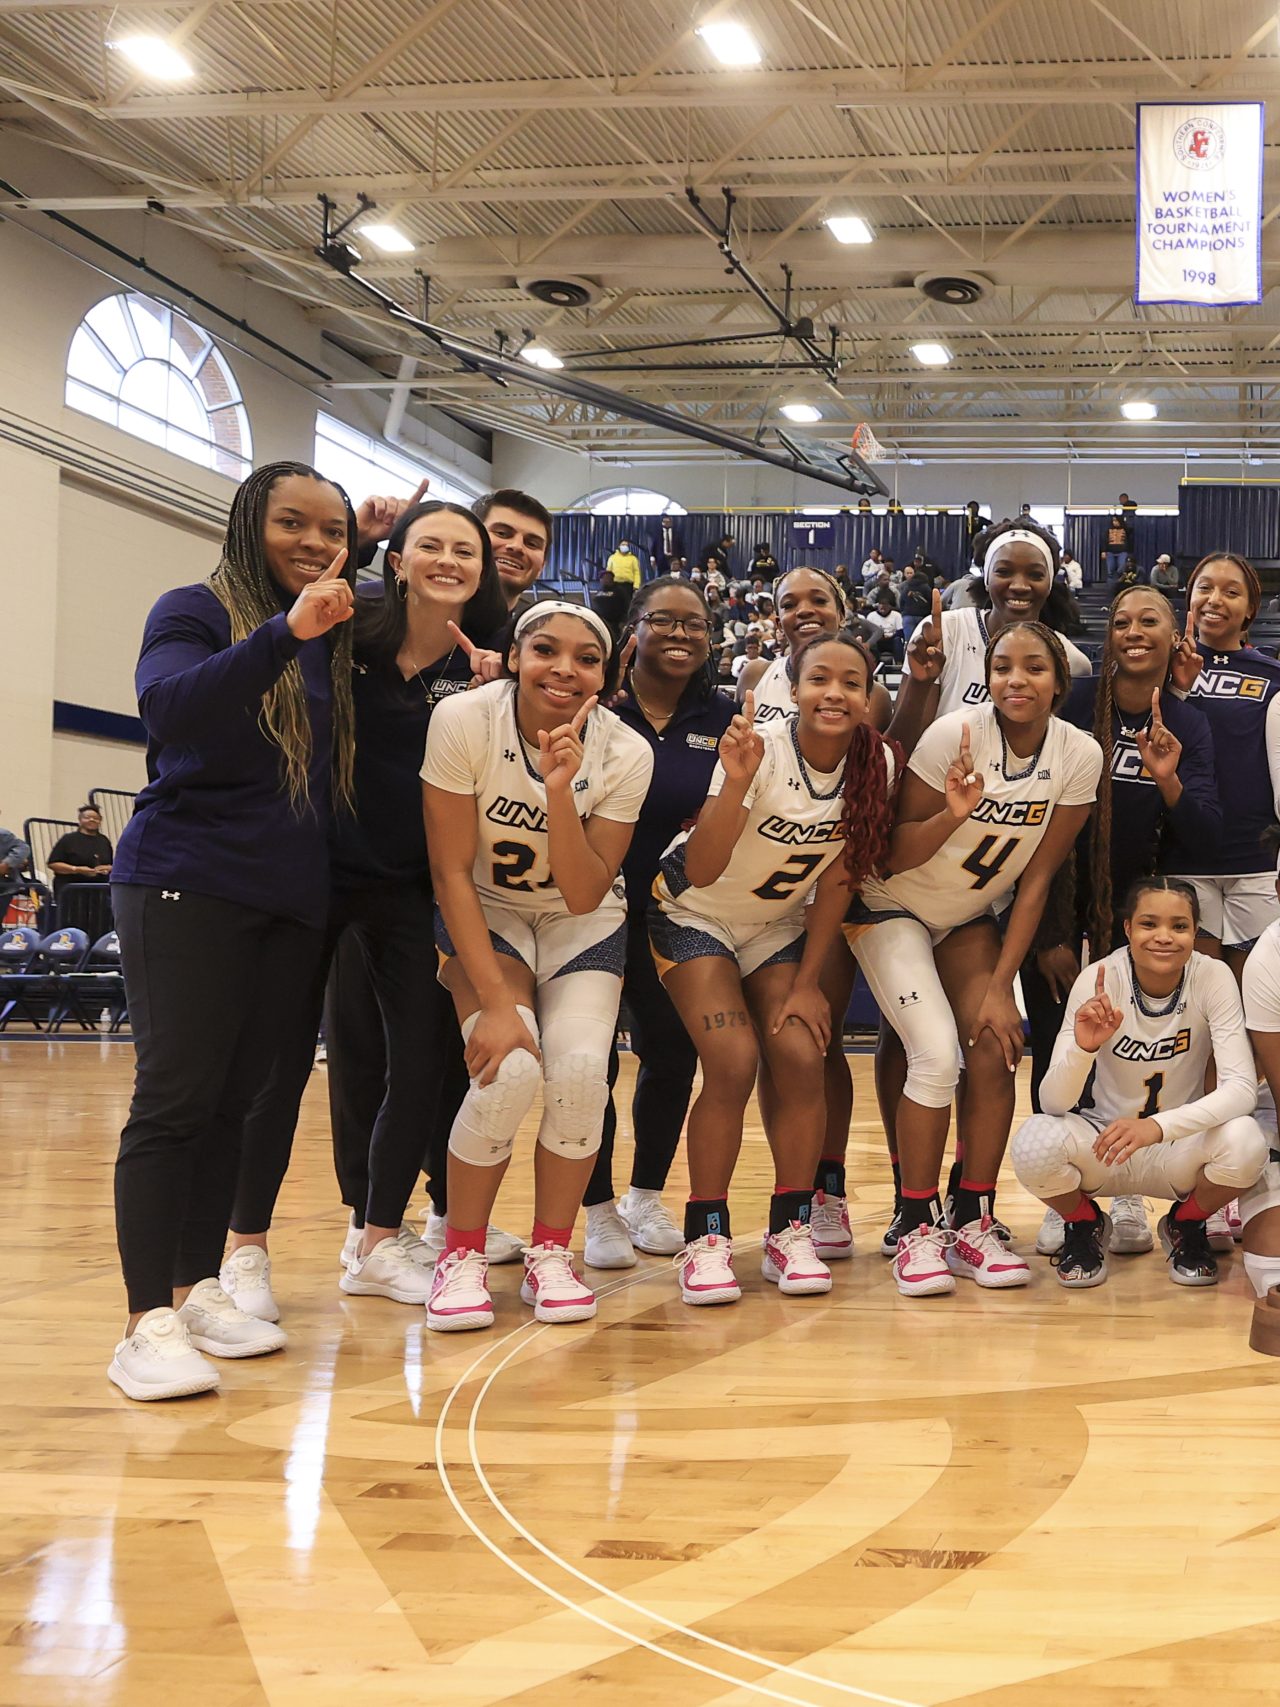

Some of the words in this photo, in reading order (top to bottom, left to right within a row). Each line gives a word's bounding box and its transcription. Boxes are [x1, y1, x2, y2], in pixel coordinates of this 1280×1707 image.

[1162, 190, 1236, 203] WOMEN'S
[1154, 205, 1242, 220] BASKETBALL
[1147, 221, 1251, 236] TOURNAMENT
[1152, 237, 1245, 252] CHAMPIONS
[1182, 269, 1217, 286] 1998
[793, 521, 831, 529] SECTION
[808, 529, 815, 545] 1
[430, 679, 472, 694] UNC
[1189, 669, 1271, 702] NCG
[685, 732, 719, 748] UNCG
[486, 796, 549, 833] UN
[960, 834, 1023, 891] 4
[751, 853, 827, 900] 2
[703, 1011, 748, 1031] 1979
[1112, 1028, 1192, 1062] UNCG
[1137, 1071, 1166, 1120] 1
